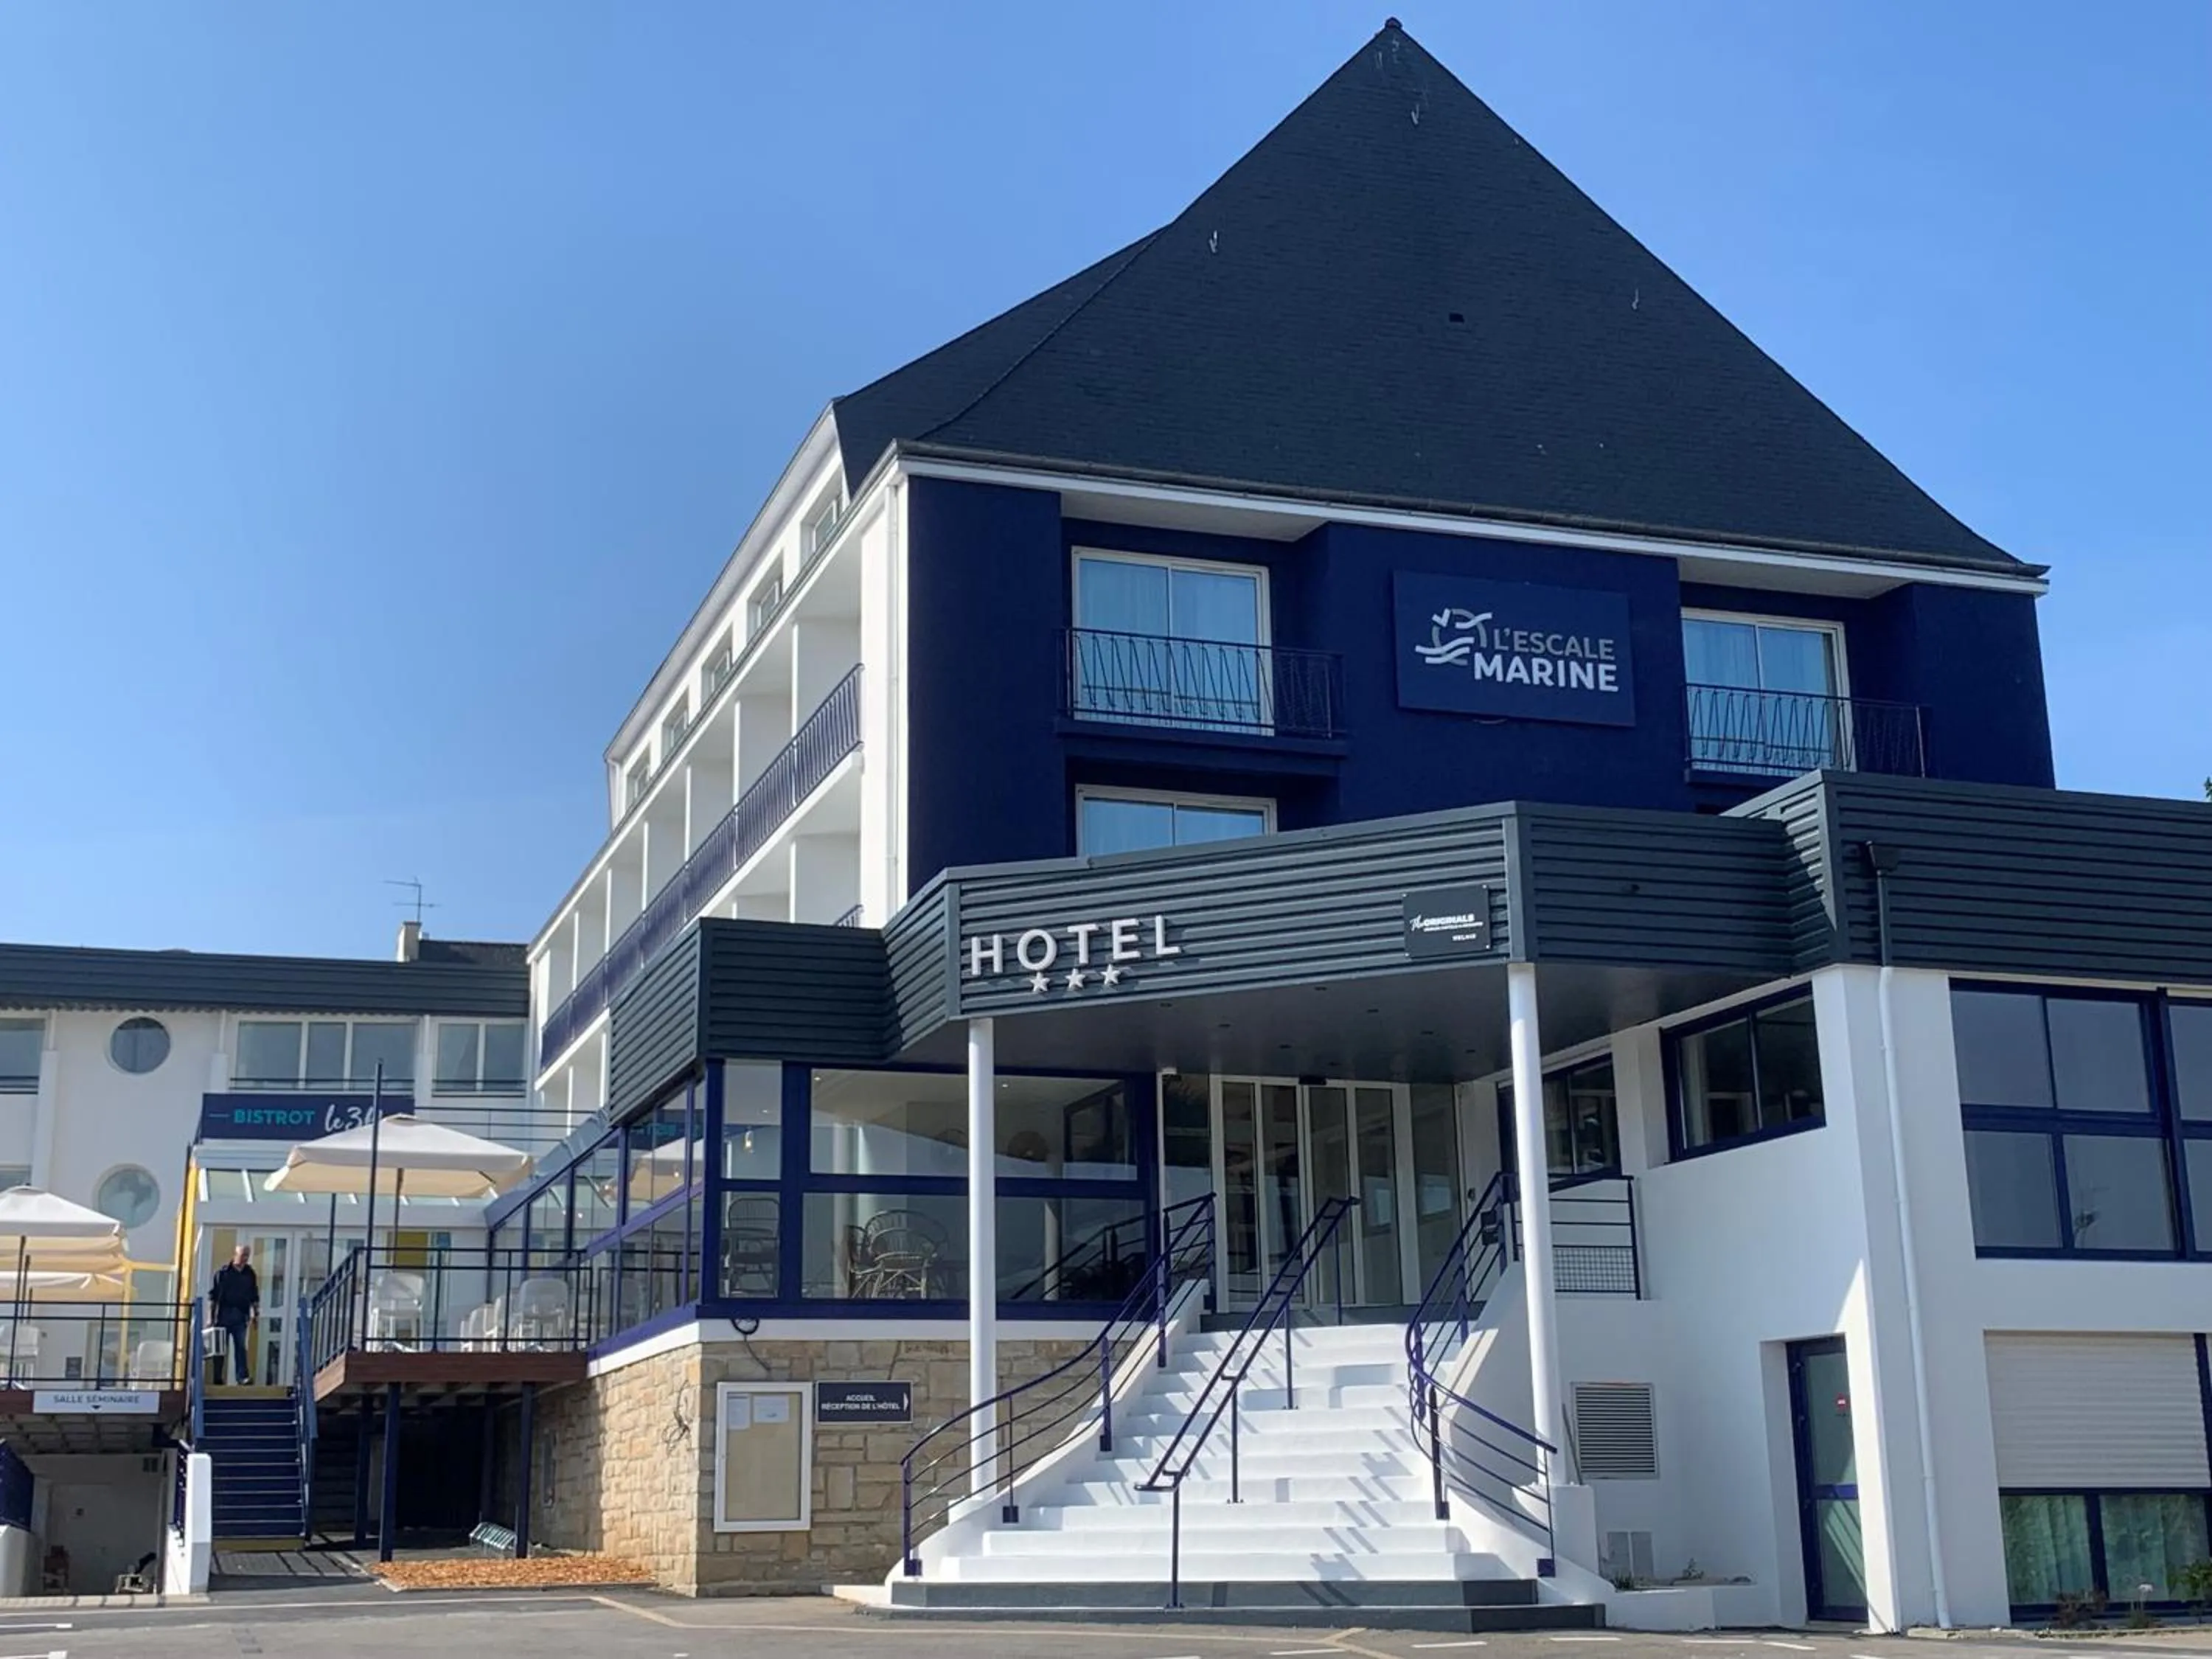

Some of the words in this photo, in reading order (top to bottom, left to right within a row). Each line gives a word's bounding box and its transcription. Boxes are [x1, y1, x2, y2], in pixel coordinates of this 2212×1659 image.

[1493, 627, 1615, 660] L'ESCALE
[1474, 652, 1618, 692] MARINE
[971, 915, 1180, 975] HOTEL
[233, 1109, 315, 1124] BISTROT
[53, 1394, 83, 1404] SALLE
[861, 1402, 872, 1411] DE
